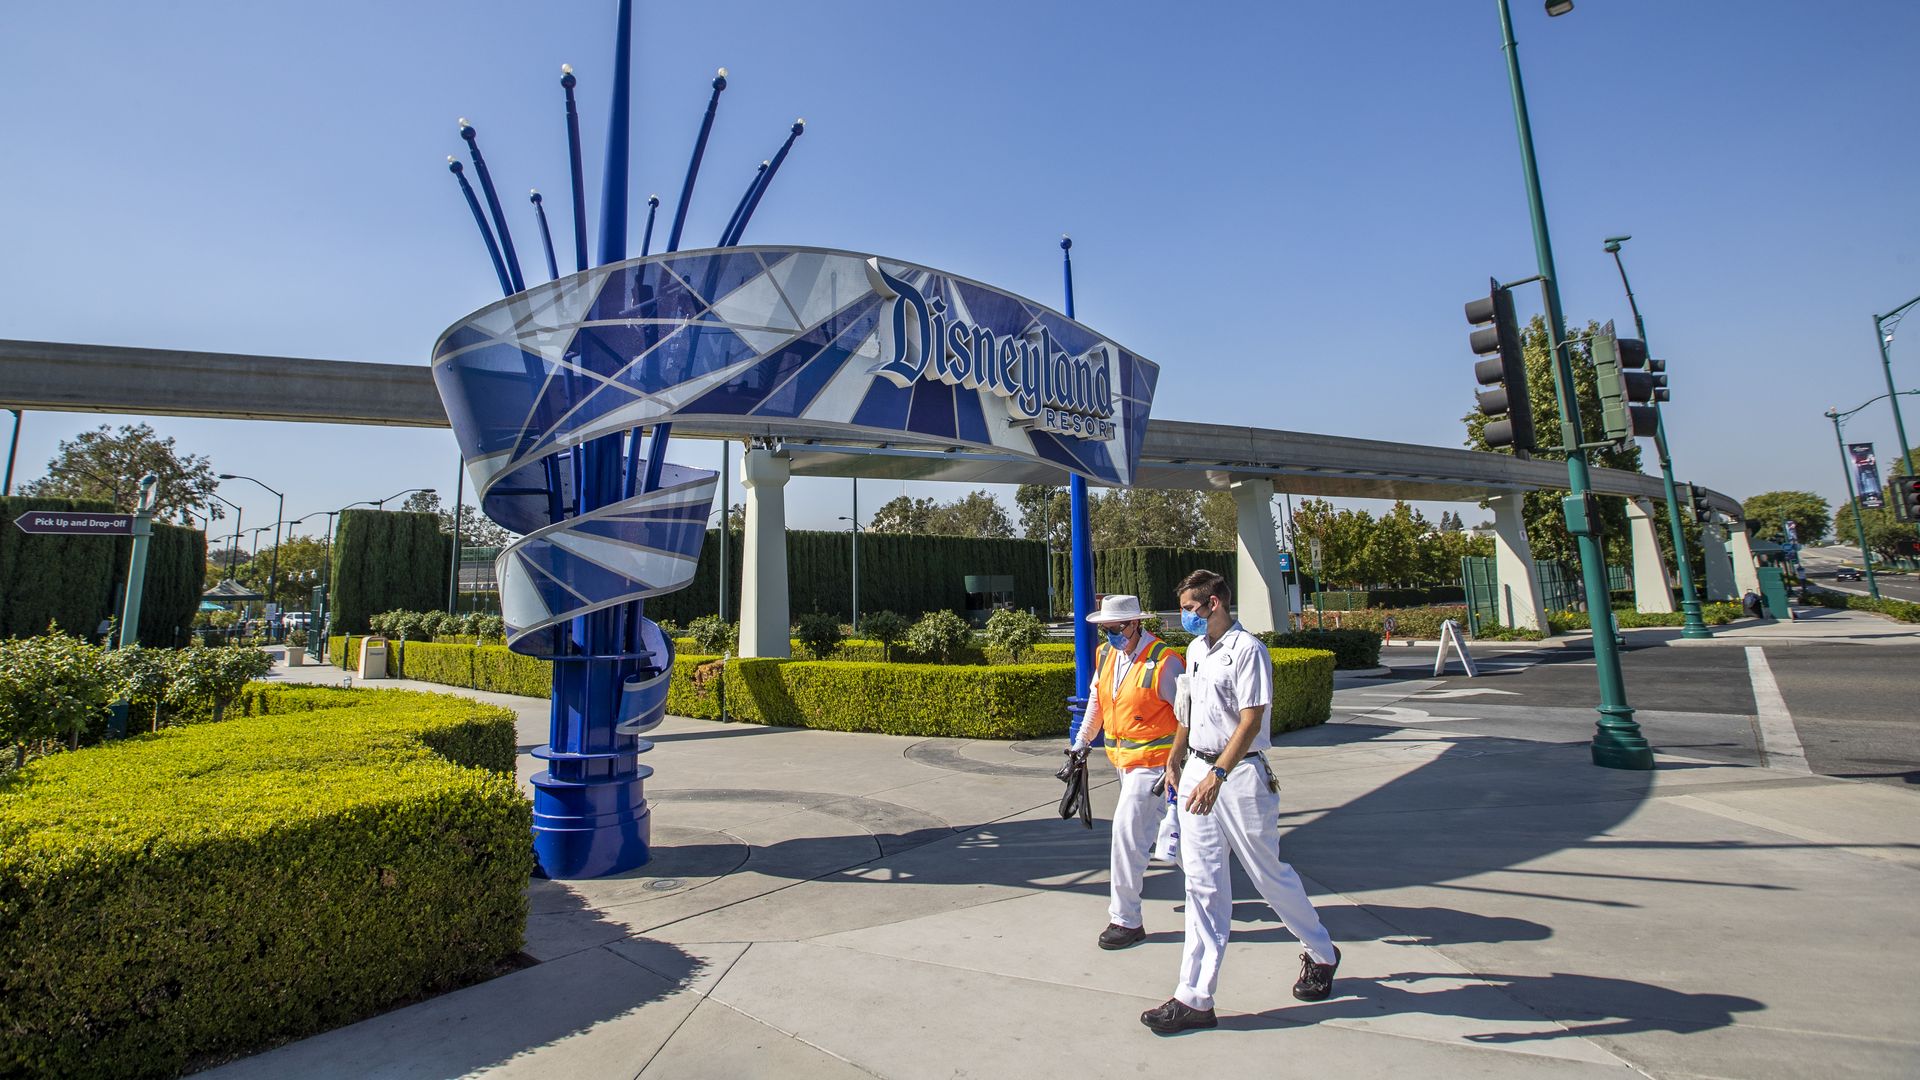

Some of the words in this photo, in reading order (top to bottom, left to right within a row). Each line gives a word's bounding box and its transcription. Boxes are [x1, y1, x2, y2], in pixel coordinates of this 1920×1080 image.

[866, 257, 1115, 419] Disneyland
[1046, 407, 1117, 440] RESORT
[34, 518, 54, 526] Pick
[56, 519, 69, 528] Up
[70, 519, 88, 527] and
[89, 519, 127, 528] Drop-Off
